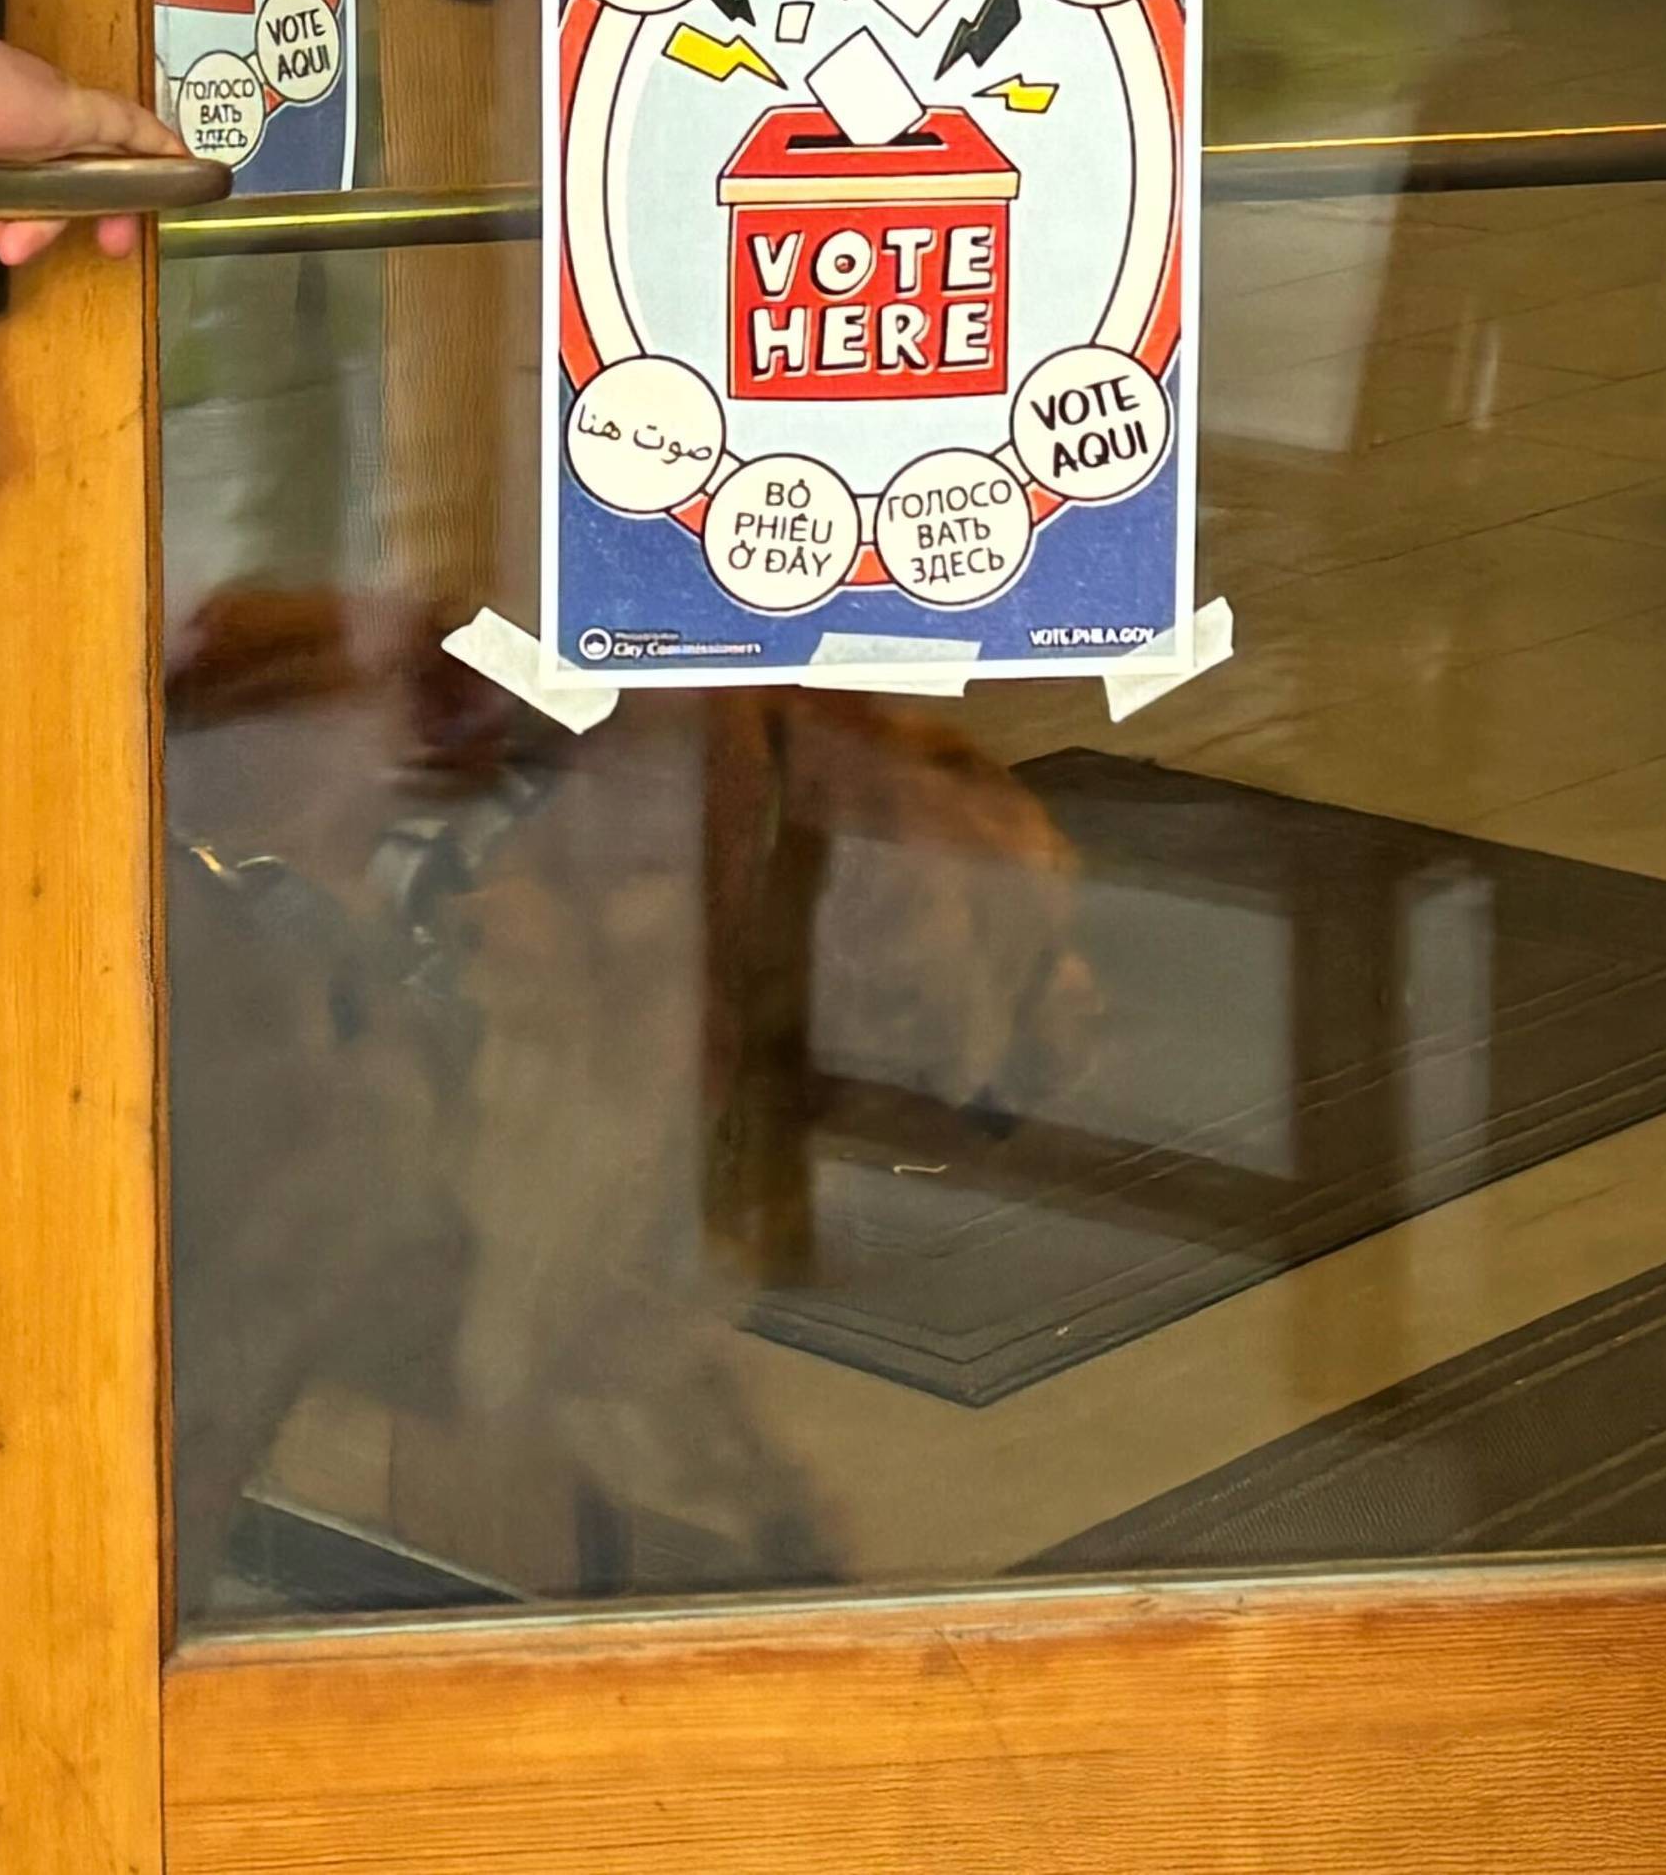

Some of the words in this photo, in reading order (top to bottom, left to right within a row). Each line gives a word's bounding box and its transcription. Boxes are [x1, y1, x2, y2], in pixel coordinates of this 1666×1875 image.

[266, 8, 326, 47] VOTE
[277, 45, 331, 82] AQUI
[185, 78, 255, 100] ГОЛОСО
[200, 104, 242, 123] ВАТЬ
[747, 224, 996, 302] VOTE
[751, 301, 994, 382] HERE
[1030, 375, 1140, 430] VOTE
[577, 404, 621, 441] هنا
[633, 425, 713, 465] صوت
[1053, 421, 1149, 478] AQUI
[887, 479, 1013, 522] ГОЛОСО
[917, 518, 991, 550] ВАТЬ
[911, 547, 1005, 585] ЗДЕСЬ
[614, 643, 642, 660] City
